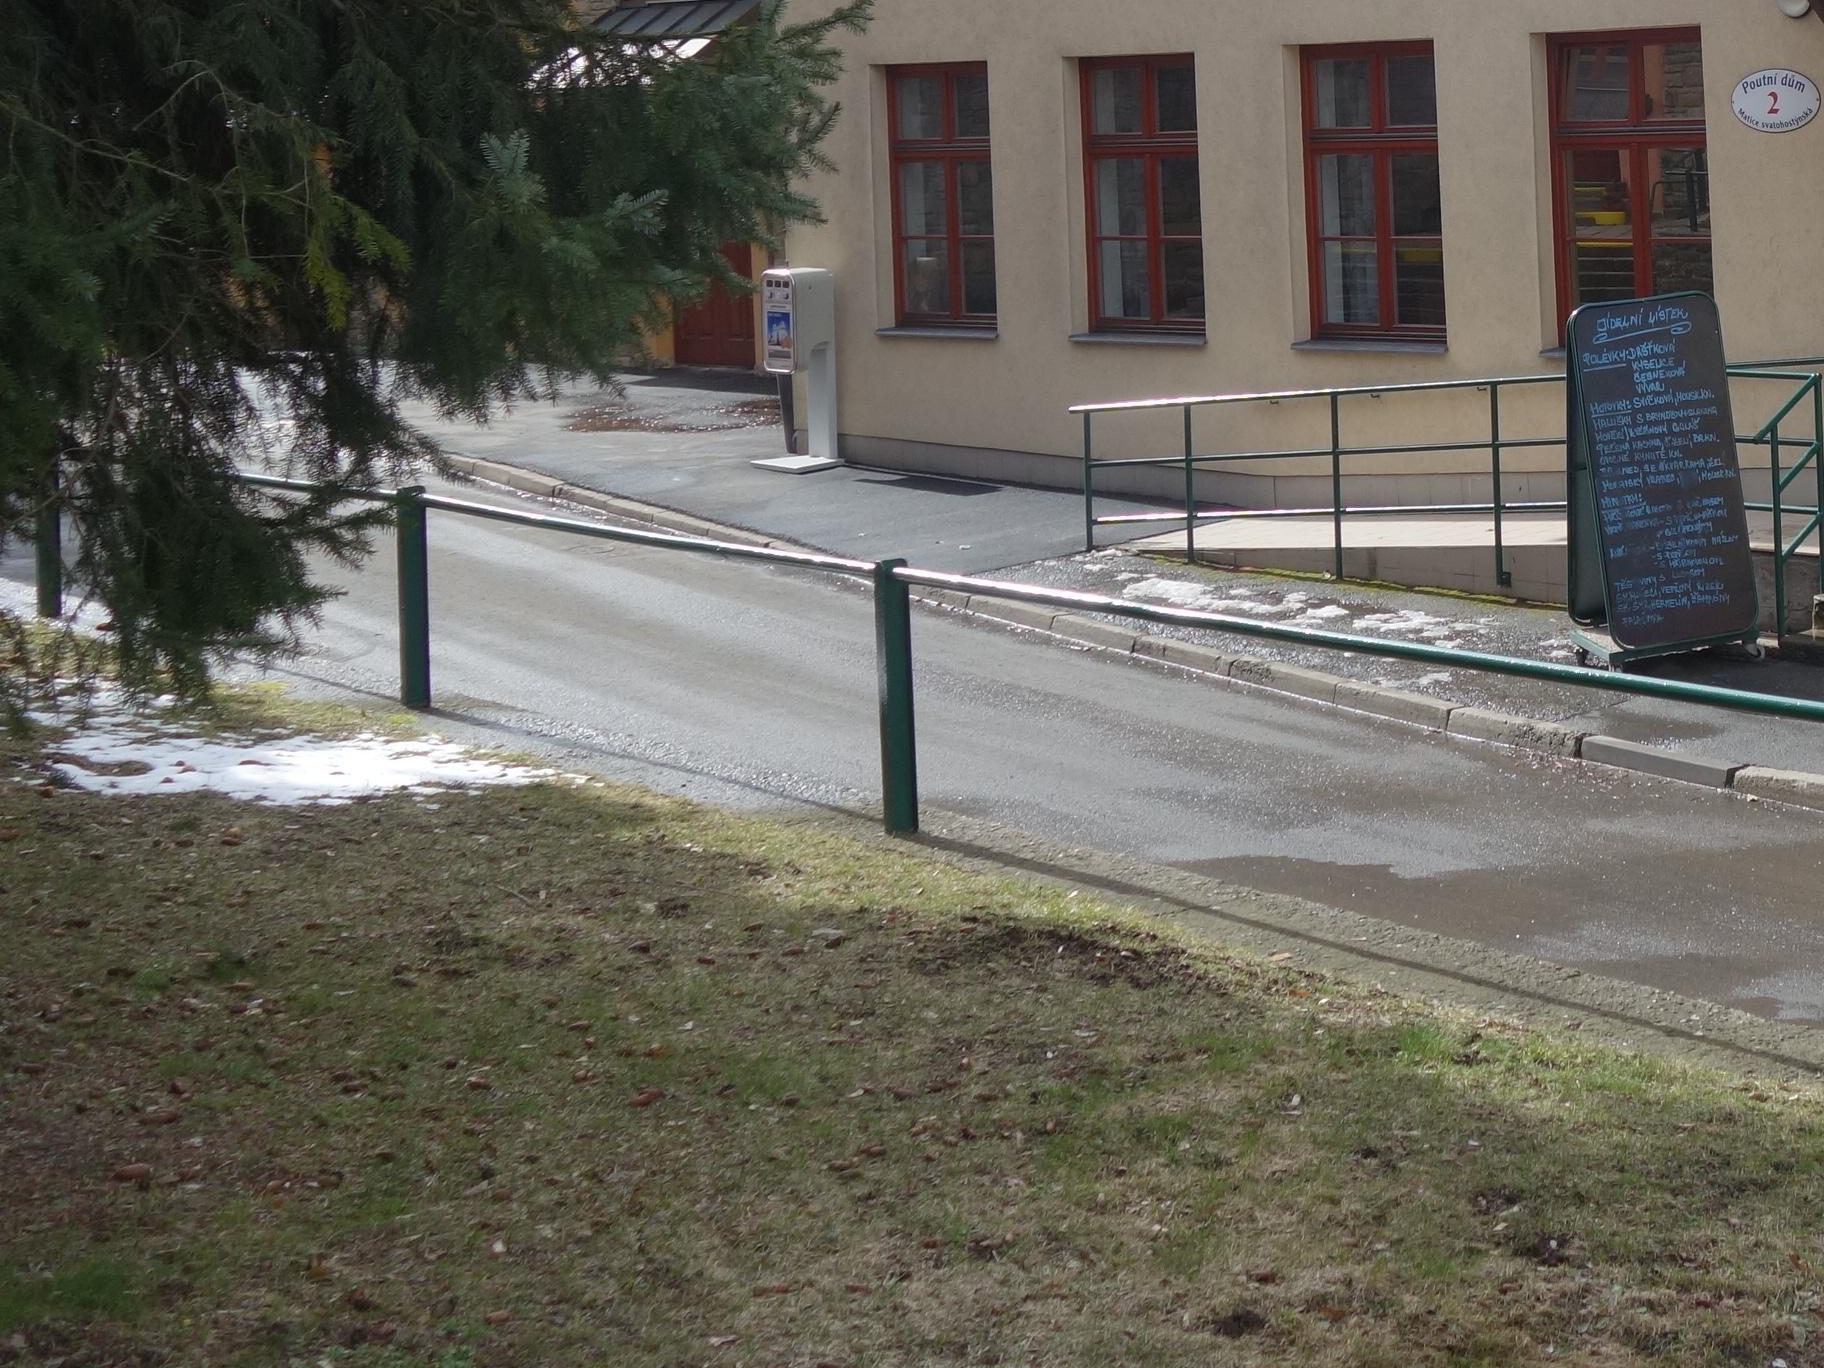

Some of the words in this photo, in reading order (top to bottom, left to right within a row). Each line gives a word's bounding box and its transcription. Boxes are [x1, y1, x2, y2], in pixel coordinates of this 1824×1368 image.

[1742, 73, 1778, 94] Poutní
[1781, 73, 1806, 93] dům
[1767, 91, 1780, 114] 2
[1738, 108, 1759, 127] Matice
